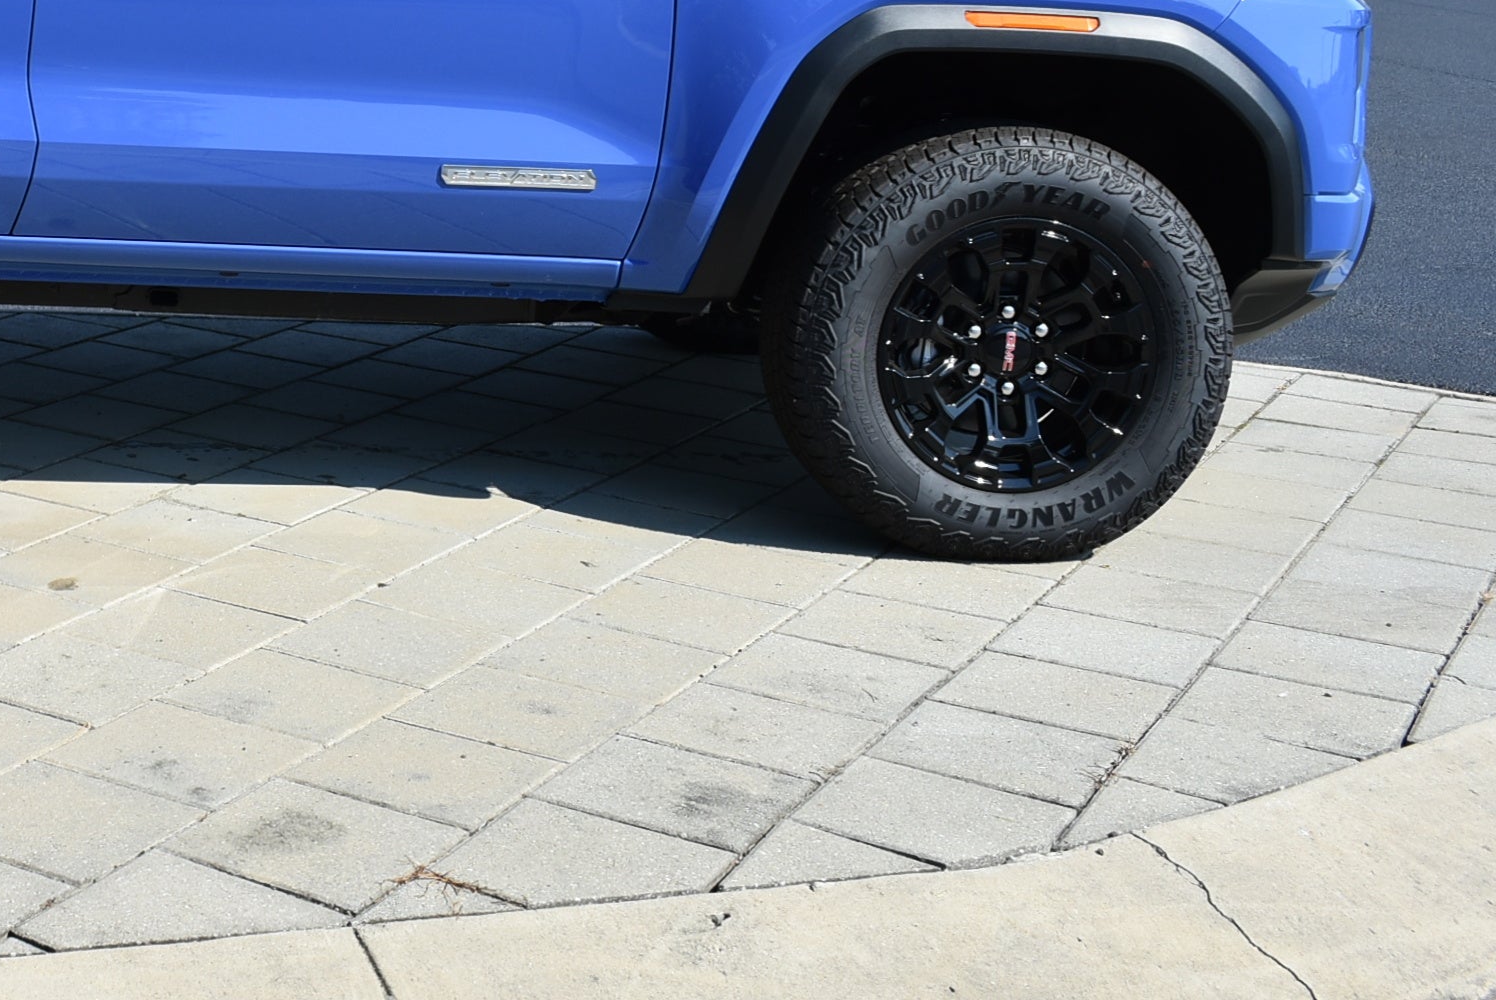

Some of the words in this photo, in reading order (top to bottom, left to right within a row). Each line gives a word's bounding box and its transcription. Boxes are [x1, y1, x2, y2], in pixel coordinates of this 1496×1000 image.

[452, 168, 587, 184] ELEVATION
[1002, 331, 1017, 372] GMC
[933, 470, 1137, 529] WRANGLER
